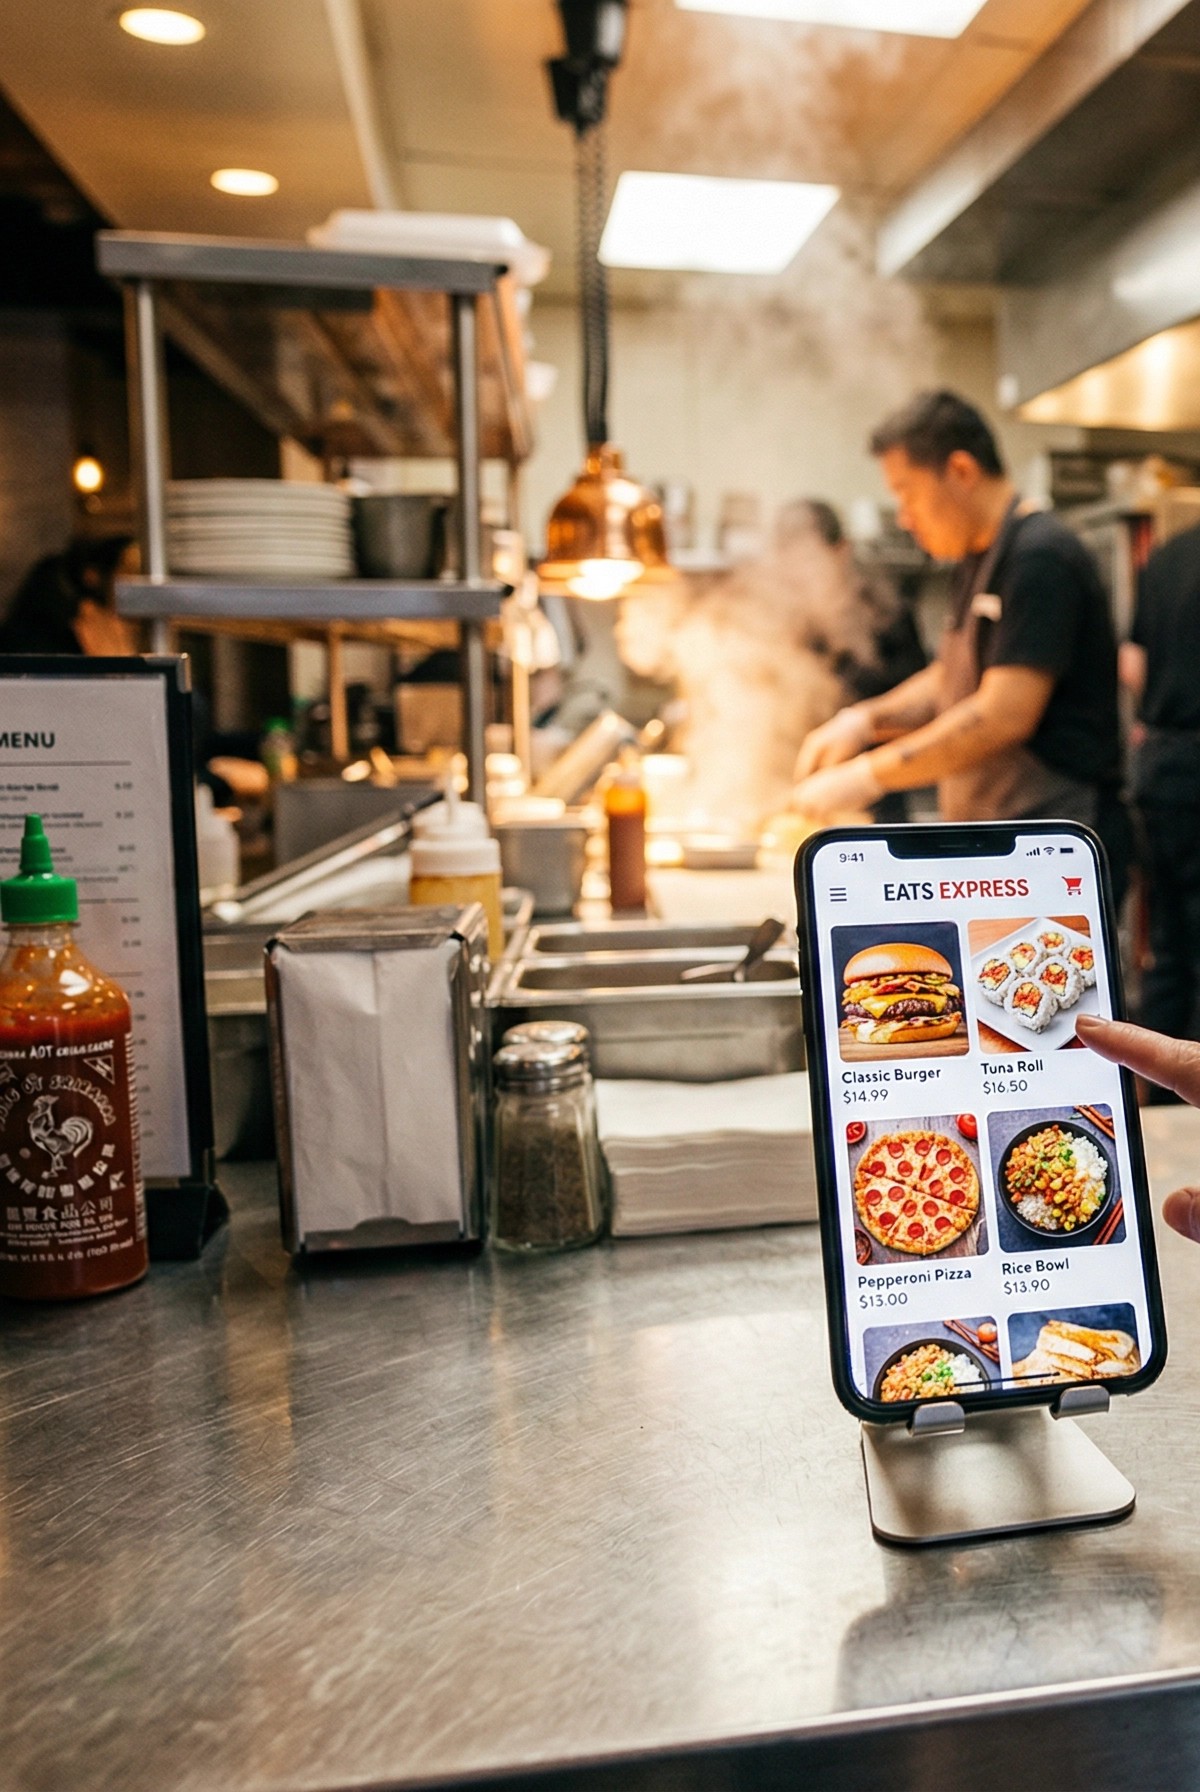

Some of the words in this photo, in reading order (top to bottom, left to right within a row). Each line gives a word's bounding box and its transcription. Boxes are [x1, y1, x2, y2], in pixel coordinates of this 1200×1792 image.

[839, 853, 865, 863] 9:41
[884, 883, 934, 901] EATS
[939, 879, 1029, 899] EXPRESS
[841, 1071, 891, 1085] Classic
[894, 1067, 942, 1083] Burger
[980, 1063, 1014, 1076] Tuna
[1017, 1059, 1044, 1073] Roll
[982, 1079, 1028, 1096] $16.50
[842, 1088, 889, 1105] $14.99
[1002, 1261, 1033, 1276] Rice
[1035, 1257, 1070, 1272] Bowl
[858, 1271, 931, 1290] Pepperoni
[935, 1267, 972, 1282] Pizza
[1003, 1278, 1051, 1295] $13.90
[859, 1292, 908, 1309] $13.00
